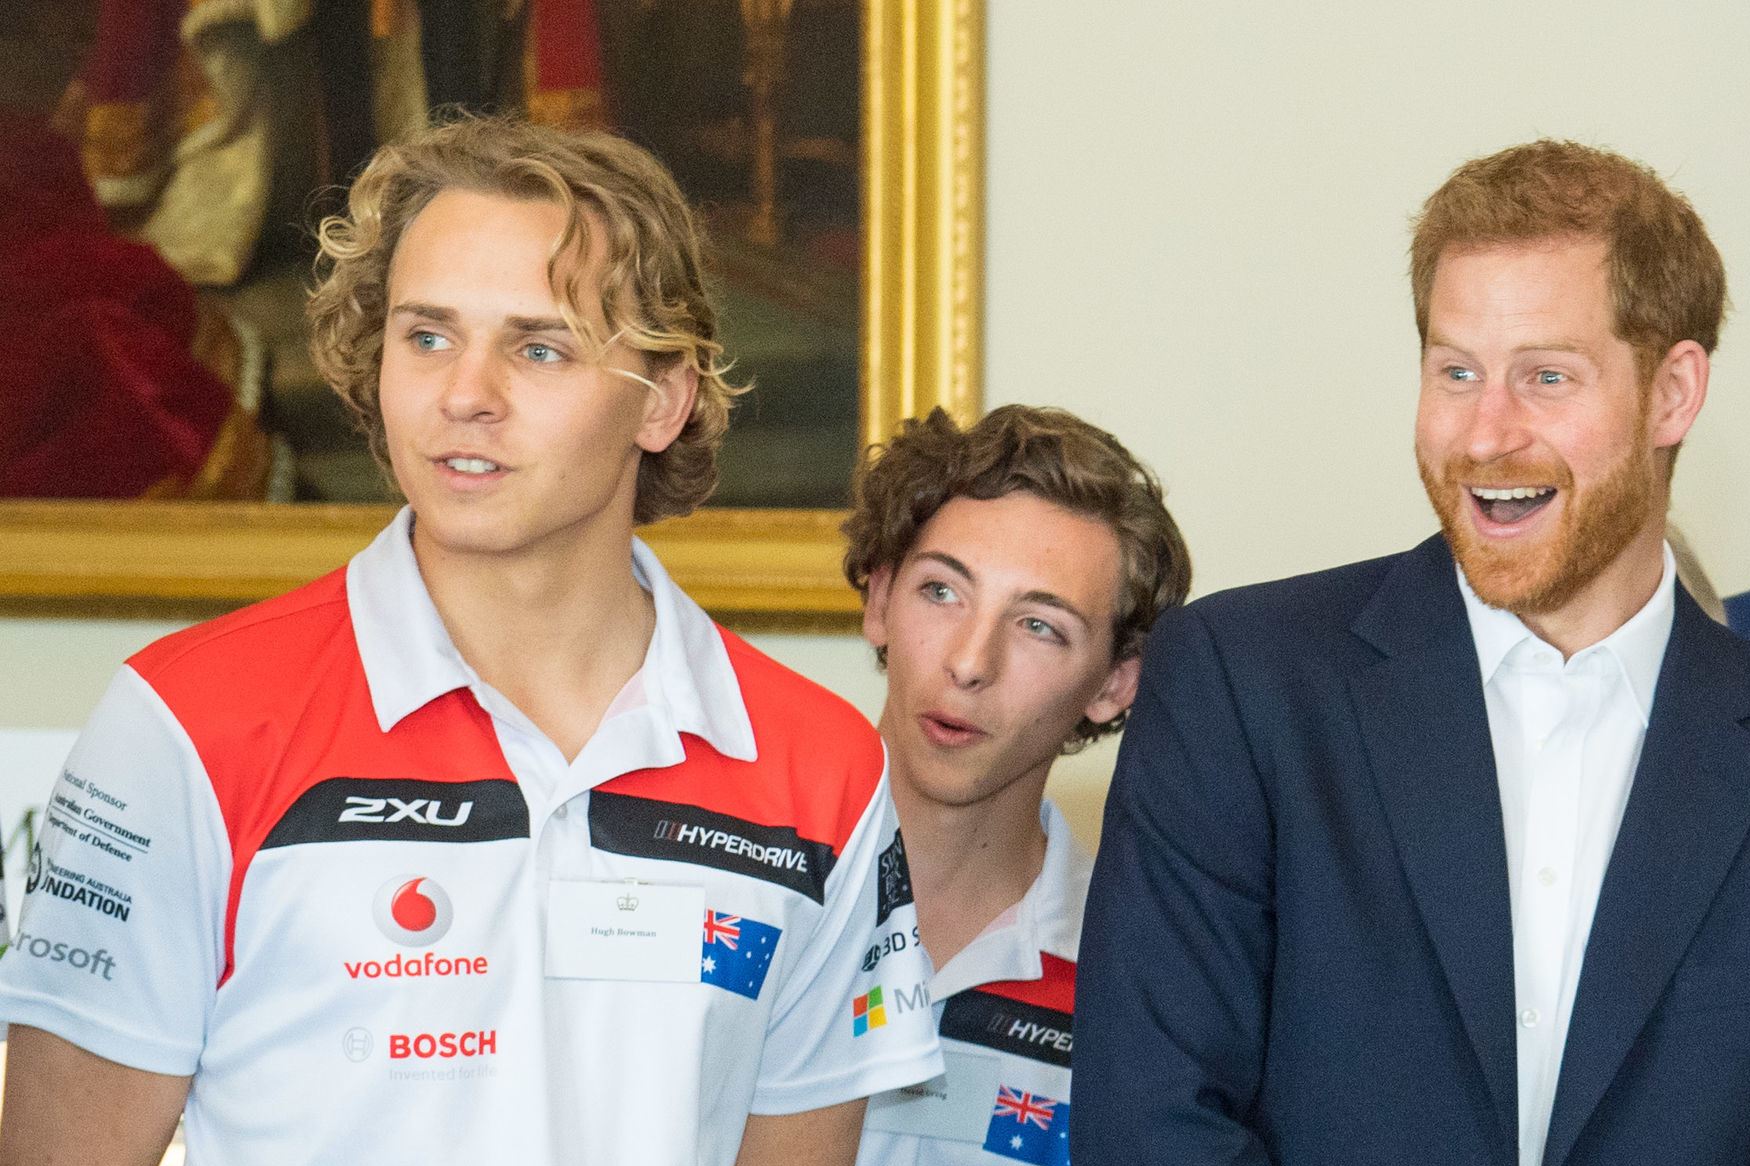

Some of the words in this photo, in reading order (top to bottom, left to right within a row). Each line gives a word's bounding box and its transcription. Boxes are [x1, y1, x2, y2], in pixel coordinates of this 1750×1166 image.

[86, 782, 128, 812] Sponsor
[338, 796, 474, 827] 2XU
[83, 807, 151, 848] Government
[79, 832, 92, 843] of
[92, 836, 133, 862] Defence
[677, 823, 808, 873] HYPERDRIVE
[86, 876, 132, 904] AUSTRALIA
[590, 926, 615, 937] Hugh
[11, 931, 117, 981] rosoft
[344, 952, 488, 979] vodafone
[894, 981, 930, 1014] Mi
[389, 1030, 496, 1059] BOSCH
[389, 1067, 456, 1081] Invented
